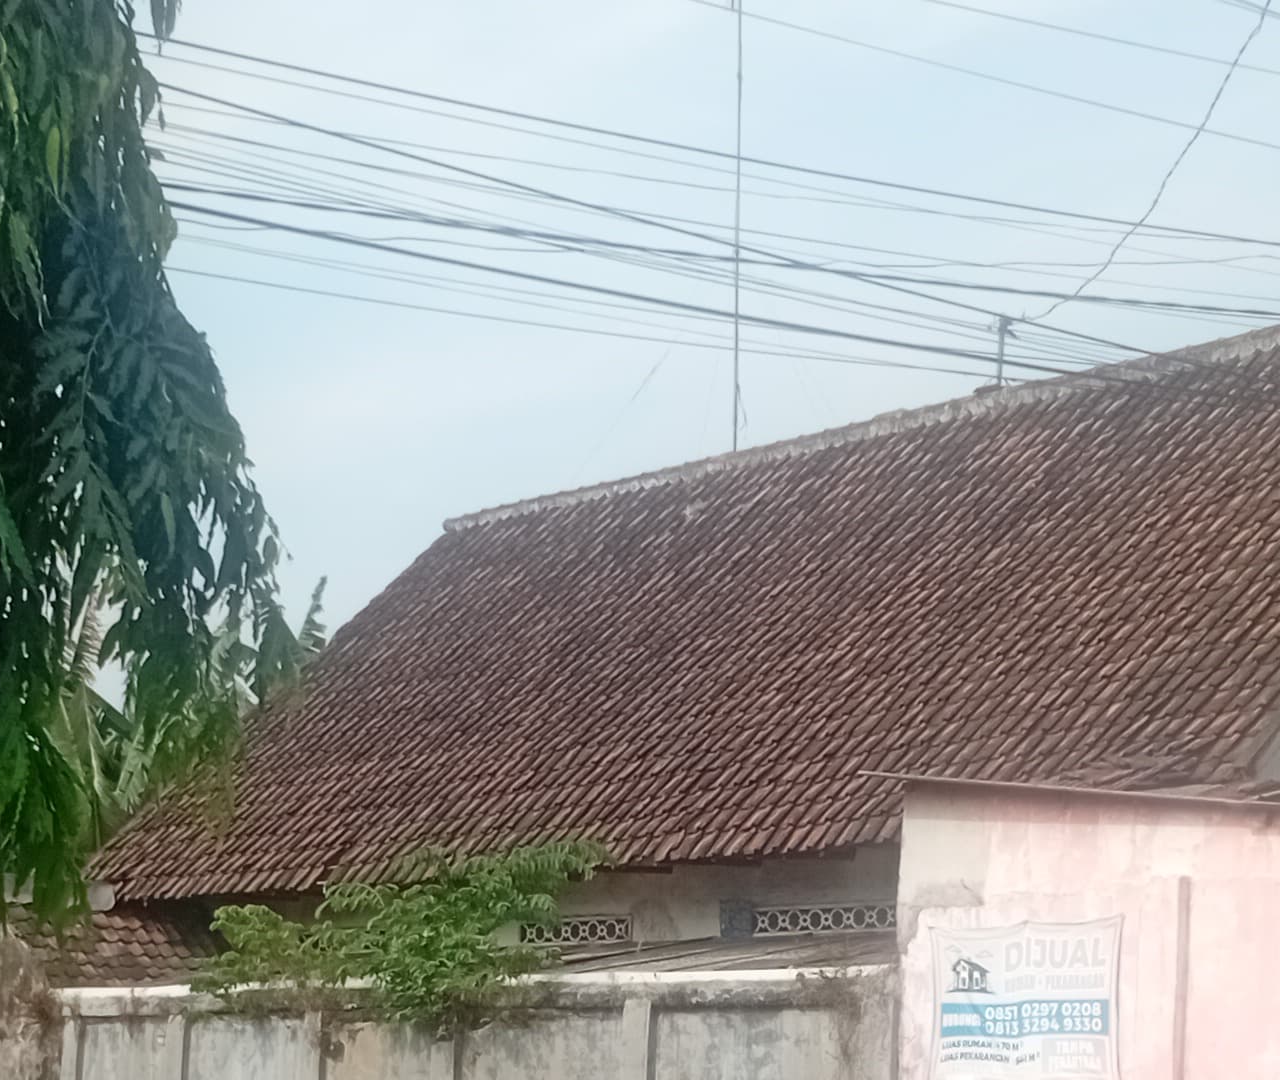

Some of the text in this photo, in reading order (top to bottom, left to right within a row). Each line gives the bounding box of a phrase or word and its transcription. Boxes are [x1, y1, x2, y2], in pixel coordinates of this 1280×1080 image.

[1005, 937, 1106, 972] DIJUAL
[984, 1002, 1102, 1020] 0851 0297 0208
[985, 1017, 1102, 1036] 0813 3294 9330
